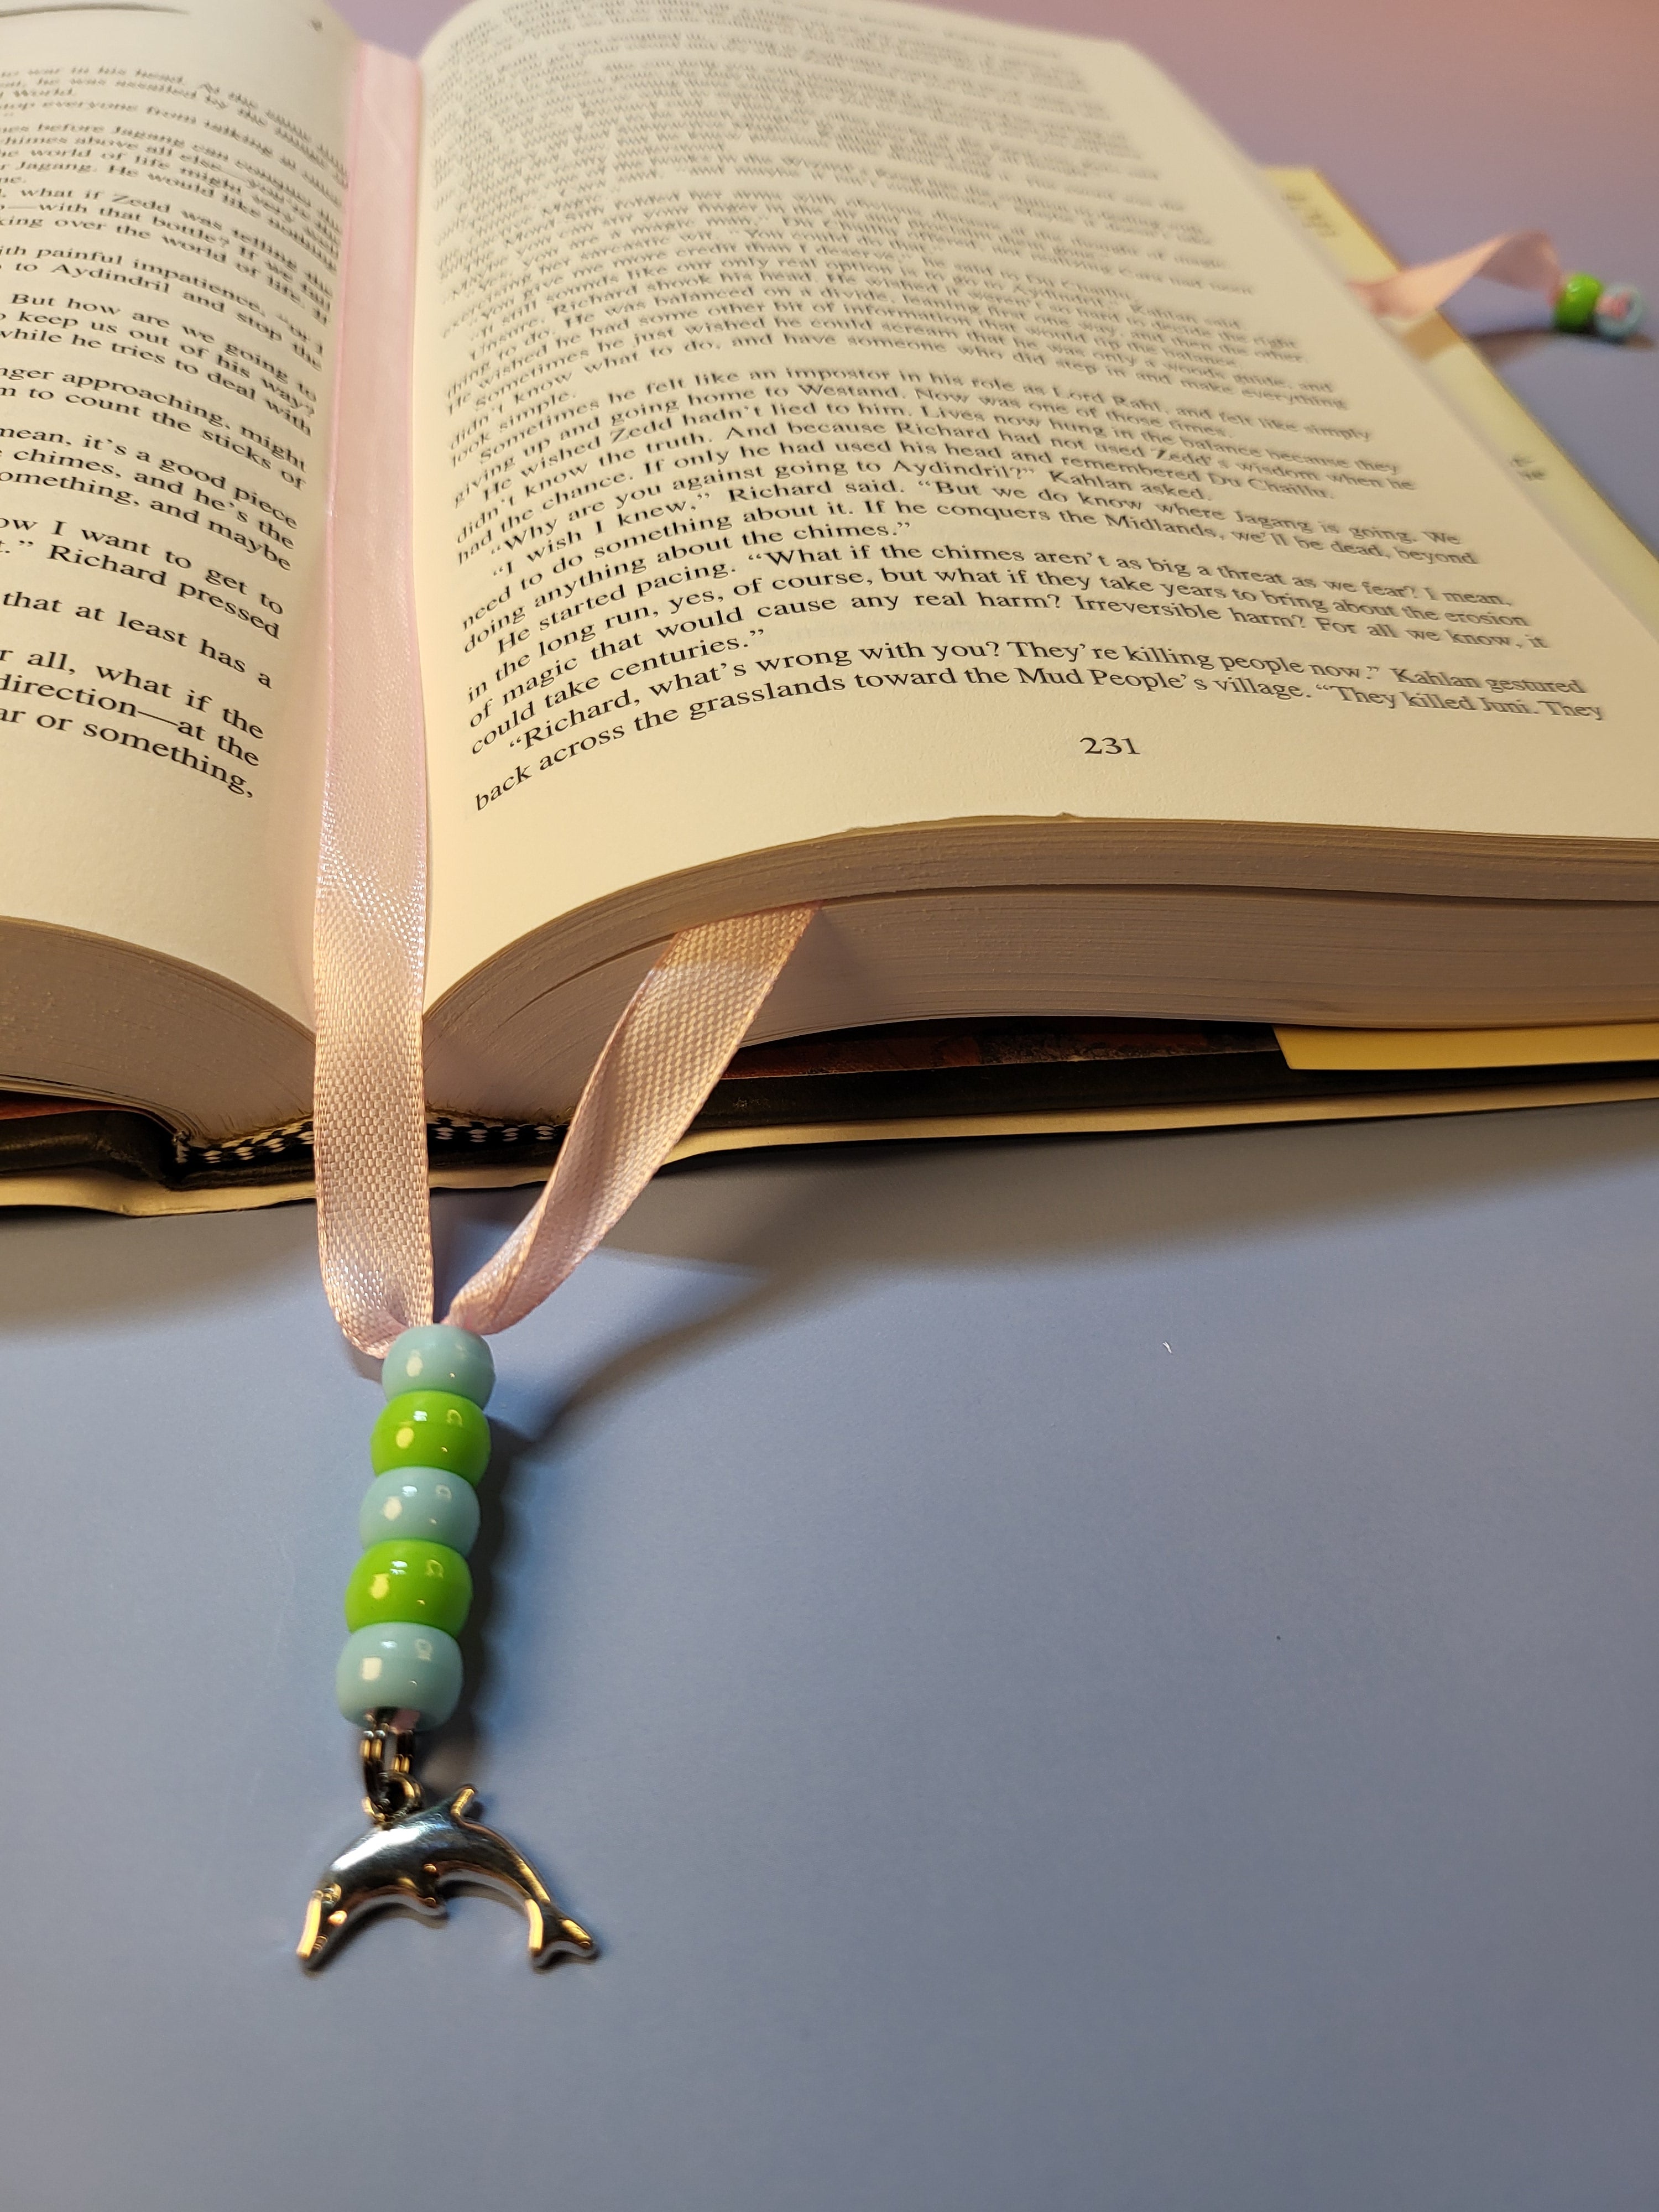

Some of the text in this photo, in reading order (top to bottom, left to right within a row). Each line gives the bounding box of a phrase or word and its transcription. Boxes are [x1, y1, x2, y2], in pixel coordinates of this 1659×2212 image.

[12, 294, 317, 403] But how are we going to
[18, 311, 79, 329] keep
[91, 321, 118, 333] us
[129, 330, 168, 347] out
[180, 345, 209, 358] of
[217, 354, 250, 379] his
[260, 377, 315, 418] way?
[71, 334, 102, 348] he
[111, 343, 165, 364] tries
[175, 360, 199, 374] to
[207, 372, 256, 401] deal
[265, 398, 311, 437] with
[29, 388, 54, 400] to
[65, 395, 139, 417] count
[152, 412, 191, 432] the
[202, 430, 272, 469] sticks
[280, 469, 306, 489] of
[62, 374, 231, 430] approaching,
[241, 426, 305, 472] might
[455, 456, 514, 508] giving
[523, 439, 550, 456] up
[560, 416, 600, 440] and
[611, 400, 677, 426] going
[687, 390, 755, 405] home
[765, 387, 789, 397] to
[914, 388, 969, 403] Now
[978, 397, 1021, 409] was
[1028, 401, 1067, 413] one
[1076, 406, 1097, 419] of
[1105, 410, 1161, 426] those
[13, 448, 294, 550] chimes, and he's the
[84, 435, 127, 455] it's
[136, 451, 150, 463] a
[159, 459, 226, 490] good
[233, 487, 297, 529] piece
[491, 460, 1212, 555] "Why are you against going to Aydindril?" Kahlan asked.
[52, 520, 67, 536] I
[81, 529, 150, 556] want
[165, 551, 192, 569] to
[205, 569, 248, 595] get
[260, 593, 283, 614] to
[150, 500, 200, 524] and
[207, 520, 290, 571] maybe
[47, 544, 279, 640] Richard pressed
[465, 521, 910, 653] doing anything about the chimes."
[468, 567, 1531, 703] in the long run, yes, of course, but what if they take years to bring about the erosion
[3, 591, 272, 689] that at least has a
[470, 591, 1549, 728] of magic that would cause any real harm? Irreversible harm? For all we know, it
[27, 651, 76, 674] all,
[96, 665, 172, 698] what
[185, 690, 213, 713] if
[223, 708, 263, 739] the
[472, 629, 764, 754] could take centuries."
[475, 667, 1603, 811] back across the grasslands toward the Mud People's village. "They killed Juni. They
[509, 641, 1587, 750] "Richard, what's wrong with you? They're killing people now." Kahlan gestured
[36, 714, 74, 731] or
[83, 723, 253, 798] something,
[217, 735, 259, 766] the
[1079, 737, 1141, 755] 231
